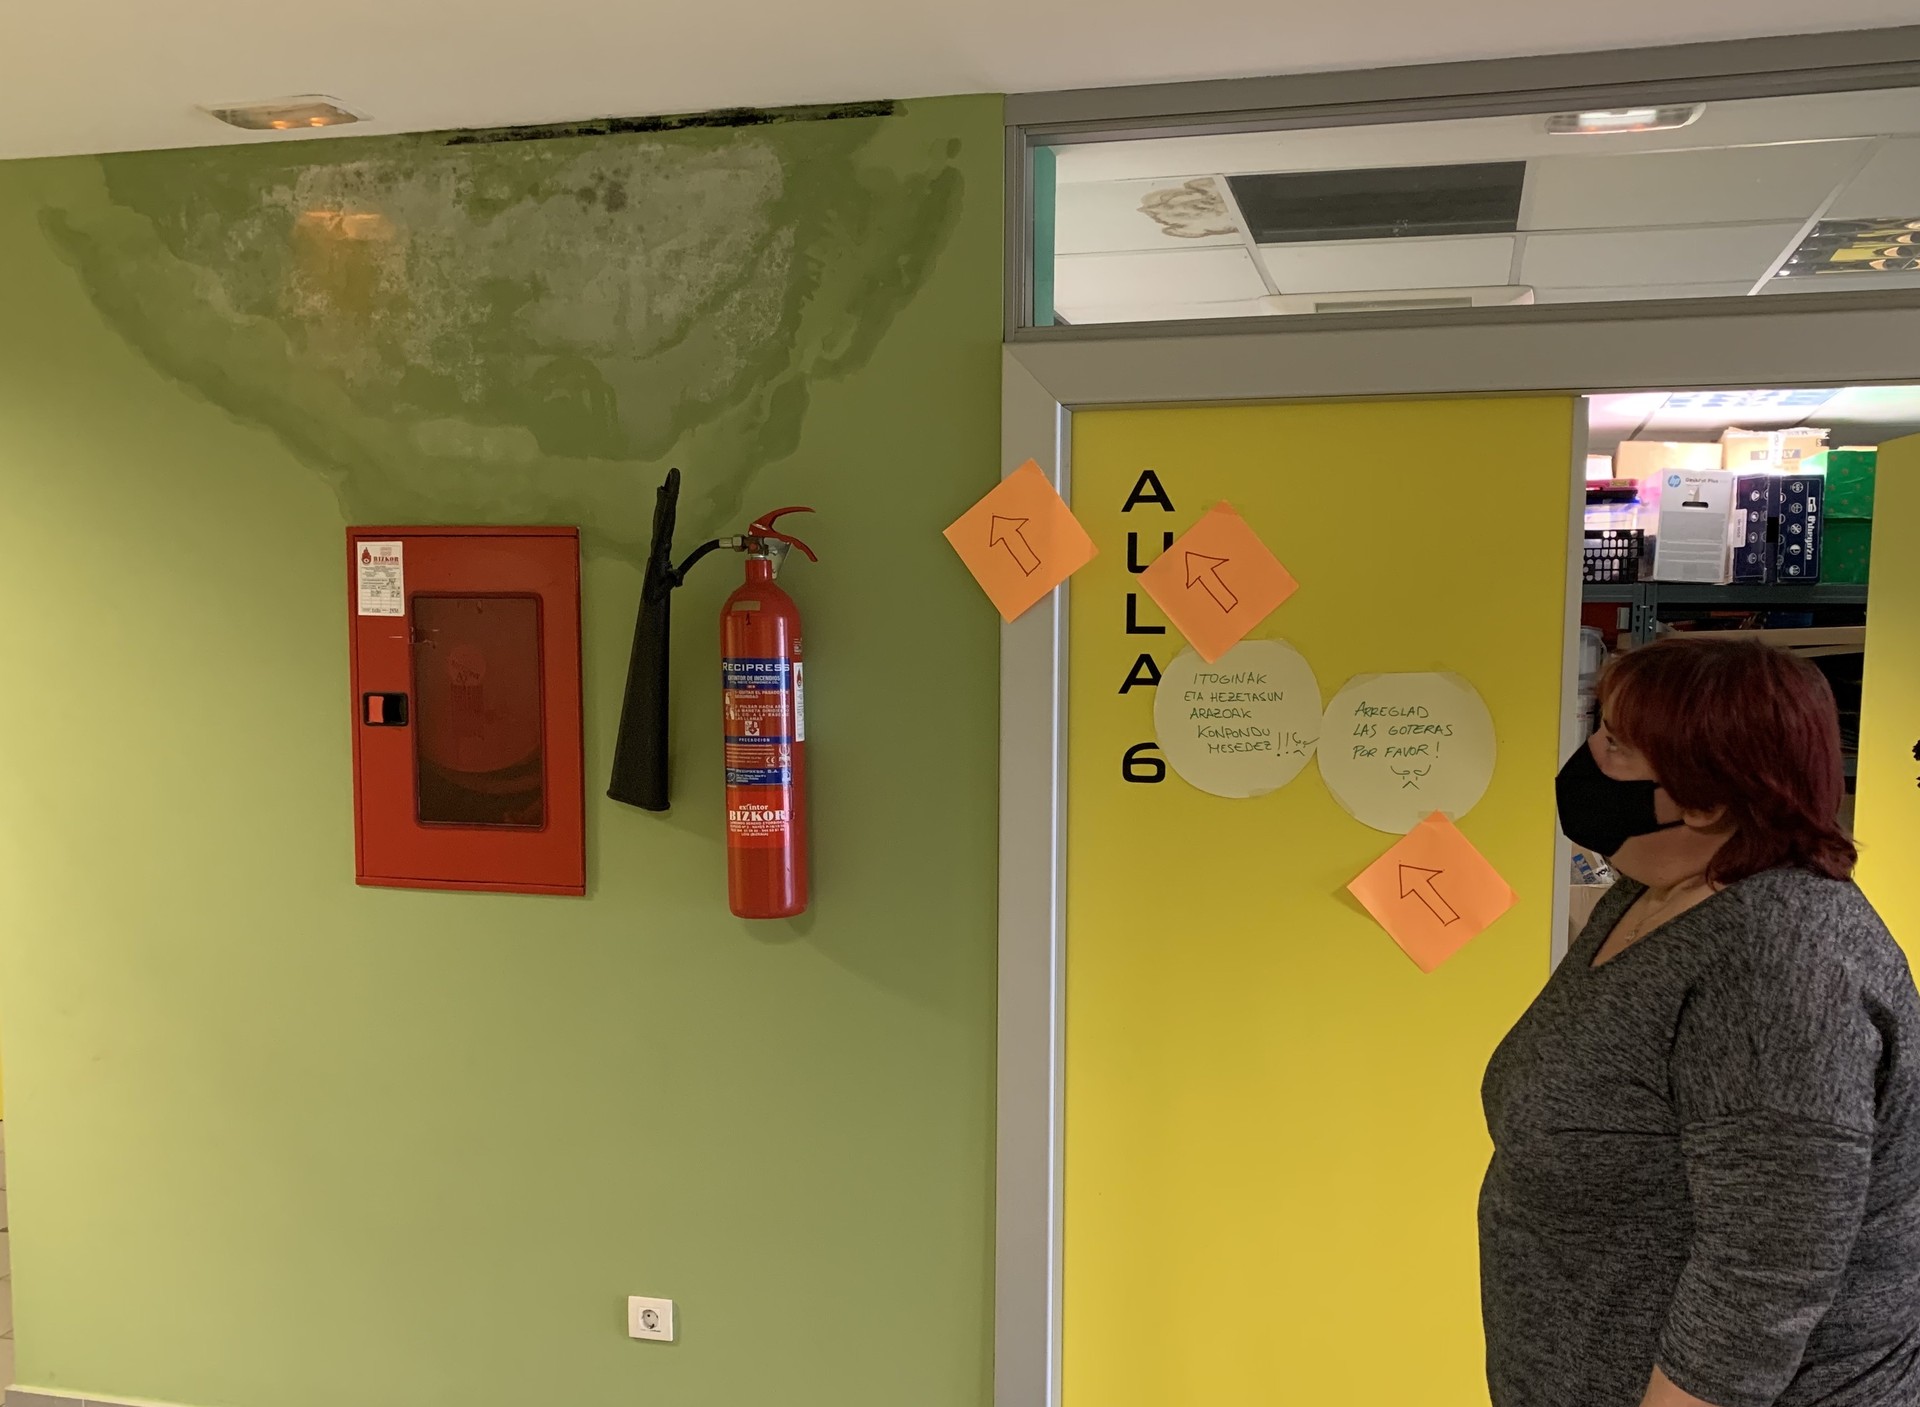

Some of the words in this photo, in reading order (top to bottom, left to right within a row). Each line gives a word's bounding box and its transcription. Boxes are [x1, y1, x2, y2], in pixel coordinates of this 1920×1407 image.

[1193, 671, 1268, 685] ITOGINAK
[1184, 690, 1204, 702] ETA
[1210, 691, 1284, 702] HEZETASUN
[1189, 707, 1252, 720] ARAZOAK
[1197, 724, 1271, 740] KONPONDU
[1352, 723, 1378, 738] LAS
[1388, 723, 1454, 737] GOTERAS
[1352, 744, 1378, 760] POR
[1121, 741, 1167, 784] 6
[729, 810, 789, 822] BIZKOR
